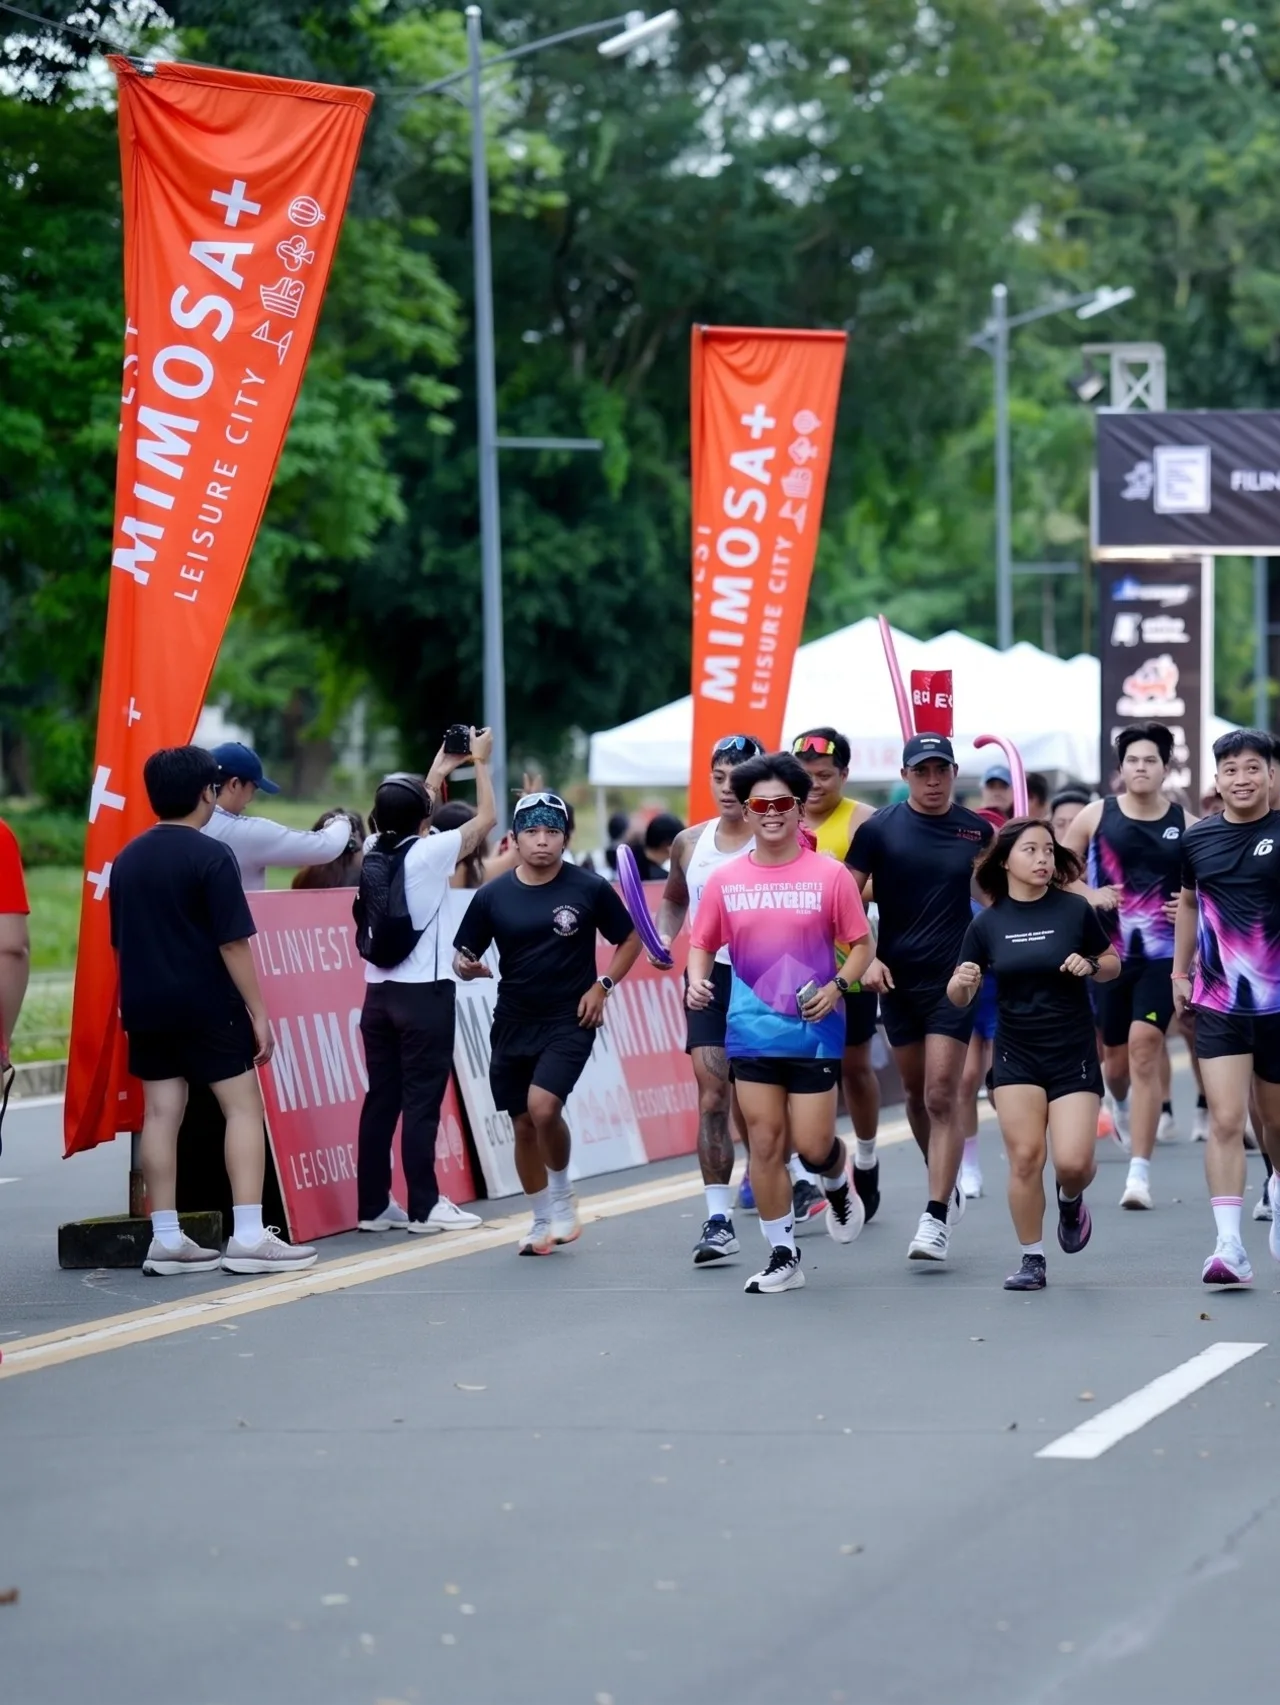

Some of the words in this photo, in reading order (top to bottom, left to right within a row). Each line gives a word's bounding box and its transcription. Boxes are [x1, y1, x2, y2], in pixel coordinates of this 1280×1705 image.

[174, 460, 238, 604] LEISURE
[225, 367, 266, 444] CITY
[750, 603, 783, 709] LEISURE
[768, 536, 794, 593] CITY
[251, 926, 353, 976] ILINVEST
[268, 1008, 370, 1113] MIMO
[606, 976, 688, 1057] MIMO
